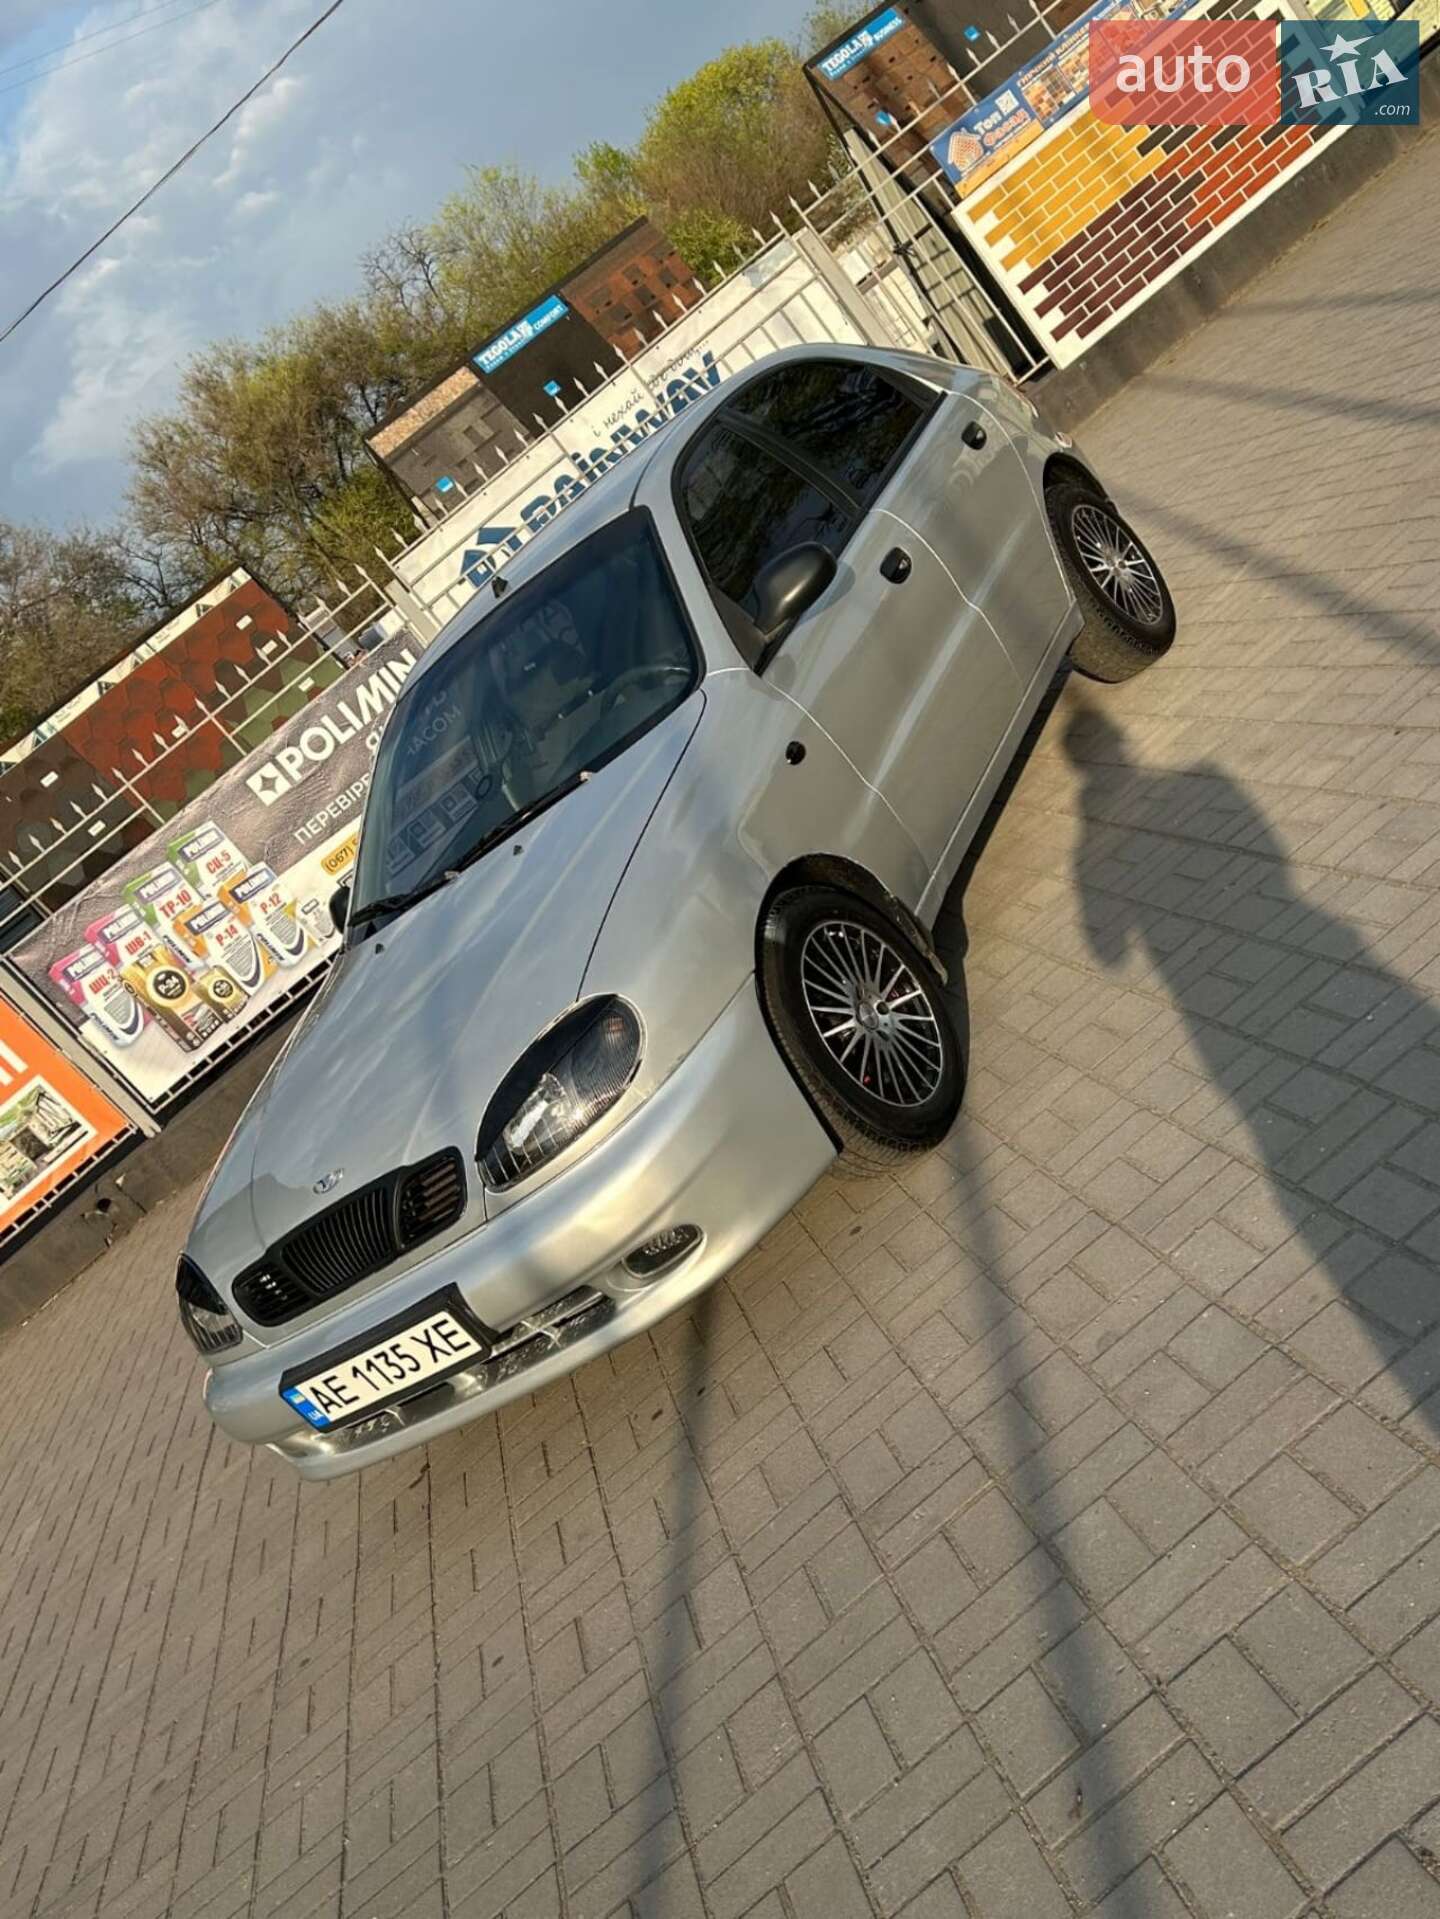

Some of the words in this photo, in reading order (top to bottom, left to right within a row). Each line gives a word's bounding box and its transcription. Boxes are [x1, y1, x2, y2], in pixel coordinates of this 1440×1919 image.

[825, 37, 865, 72] TEGOLA
[481, 328, 524, 365] TEGOLA
[276, 649, 418, 781] POLIMIN
[325, 843, 355, 874] (067)
[309, 1375, 360, 1414] AE
[352, 1344, 421, 1391] 1135
[410, 1319, 471, 1363] XE
